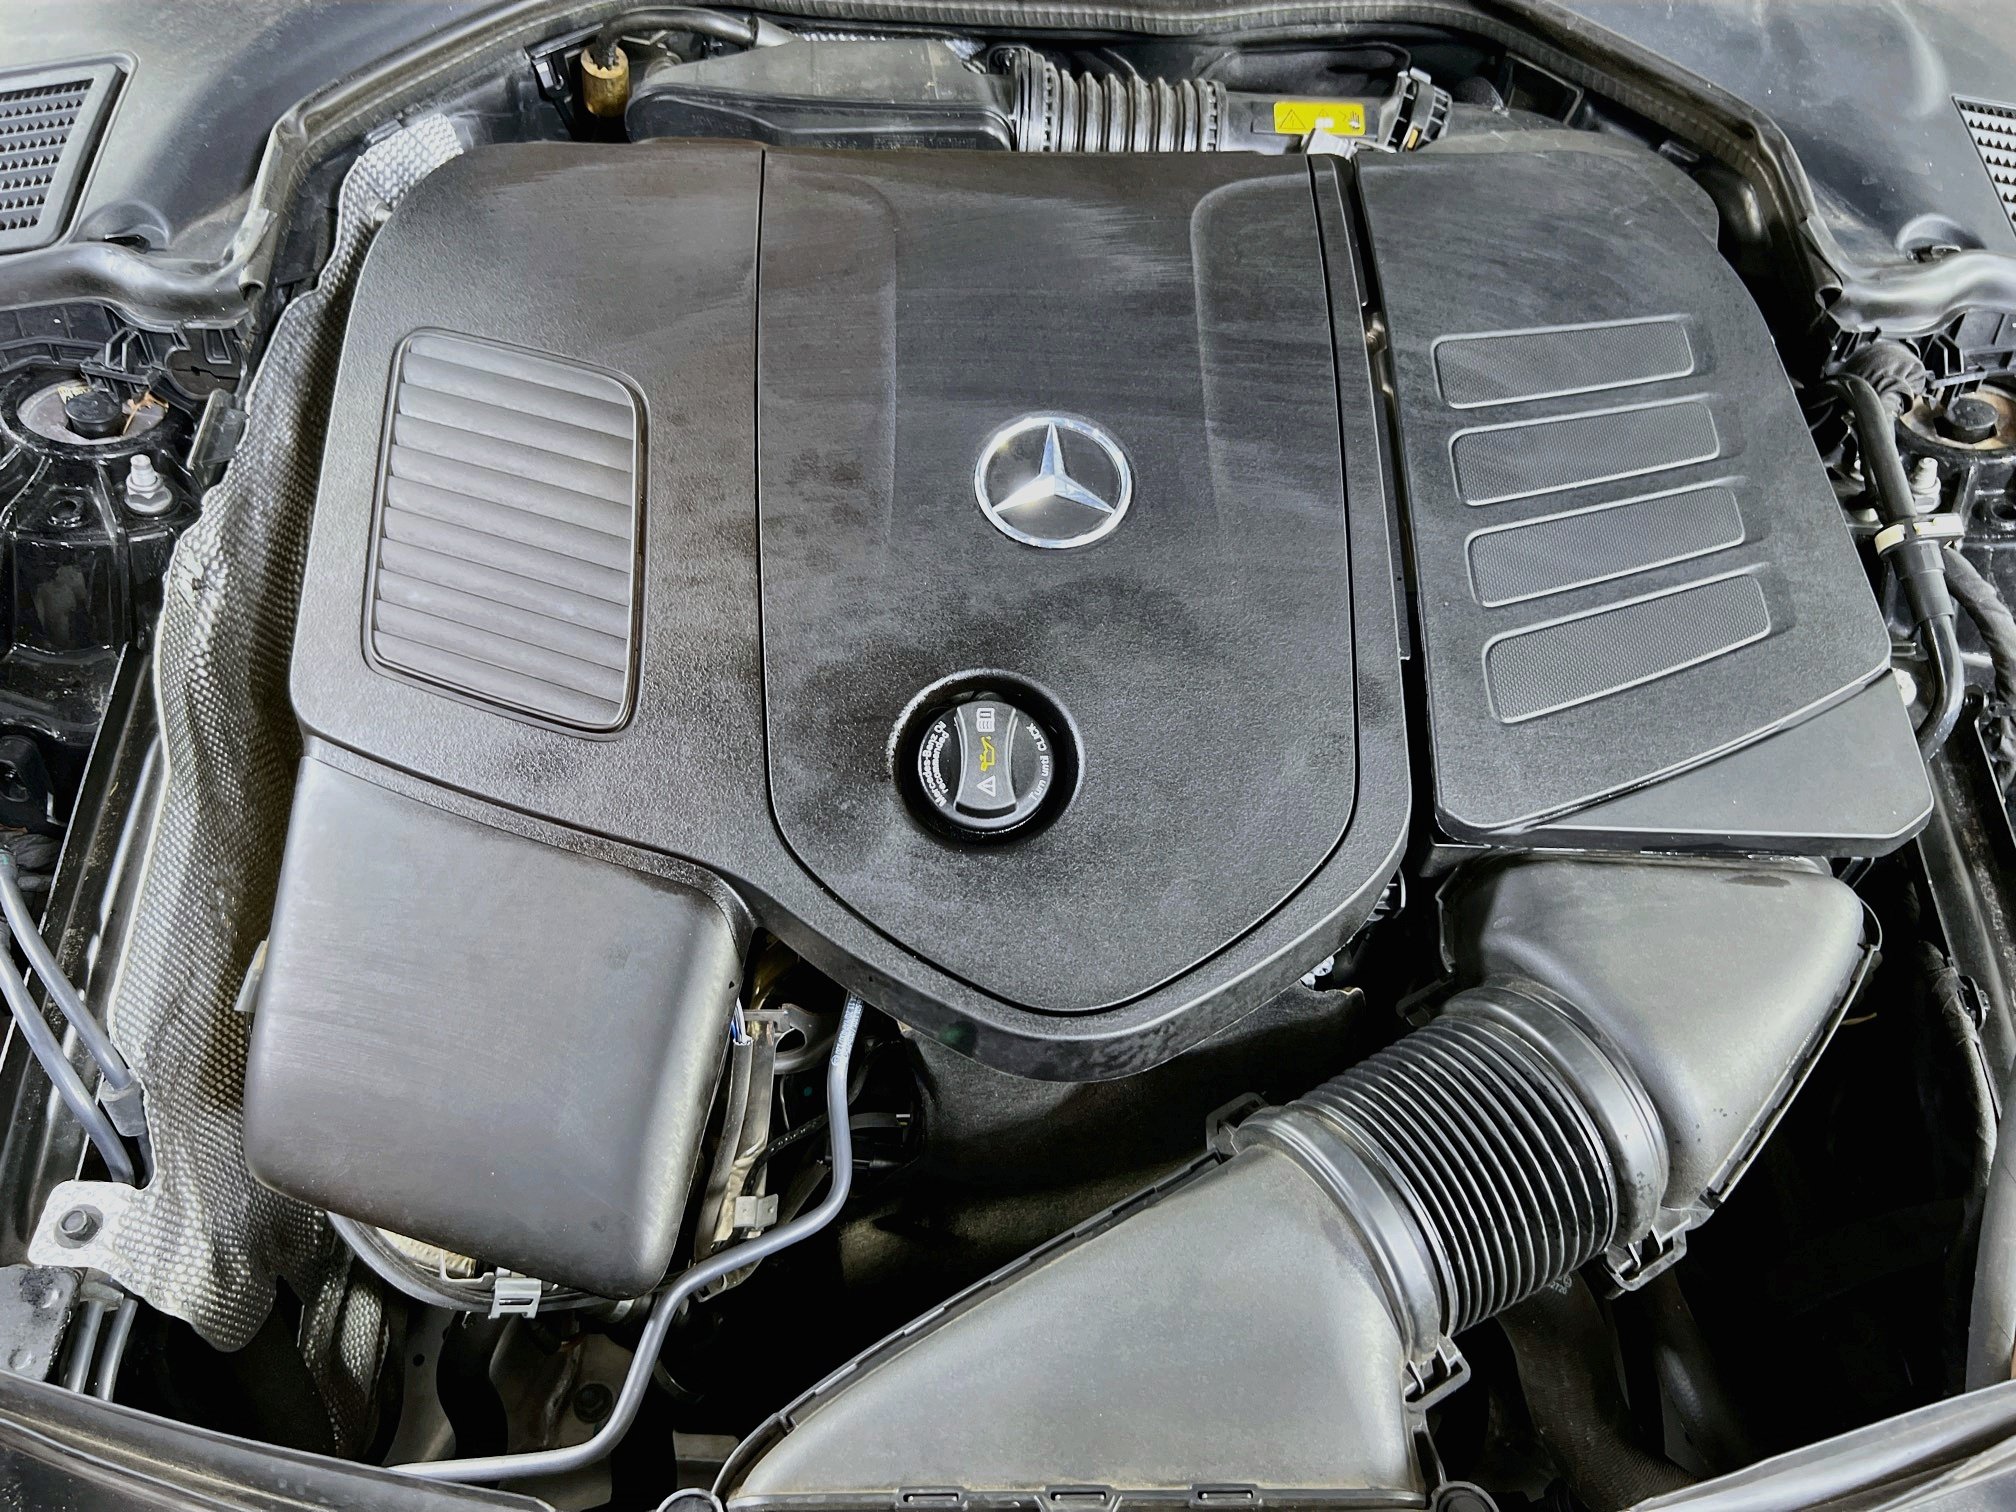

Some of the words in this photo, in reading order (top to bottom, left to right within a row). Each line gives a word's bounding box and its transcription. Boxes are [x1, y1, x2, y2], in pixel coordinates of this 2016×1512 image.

[934, 721, 947, 733] Oil
[1026, 723, 1047, 751] CLICK
[922, 733, 947, 807] Mercedes-Benz
[932, 729, 949, 794] recommended
[1040, 756, 1050, 777] until
[1029, 779, 1046, 801] Turn
